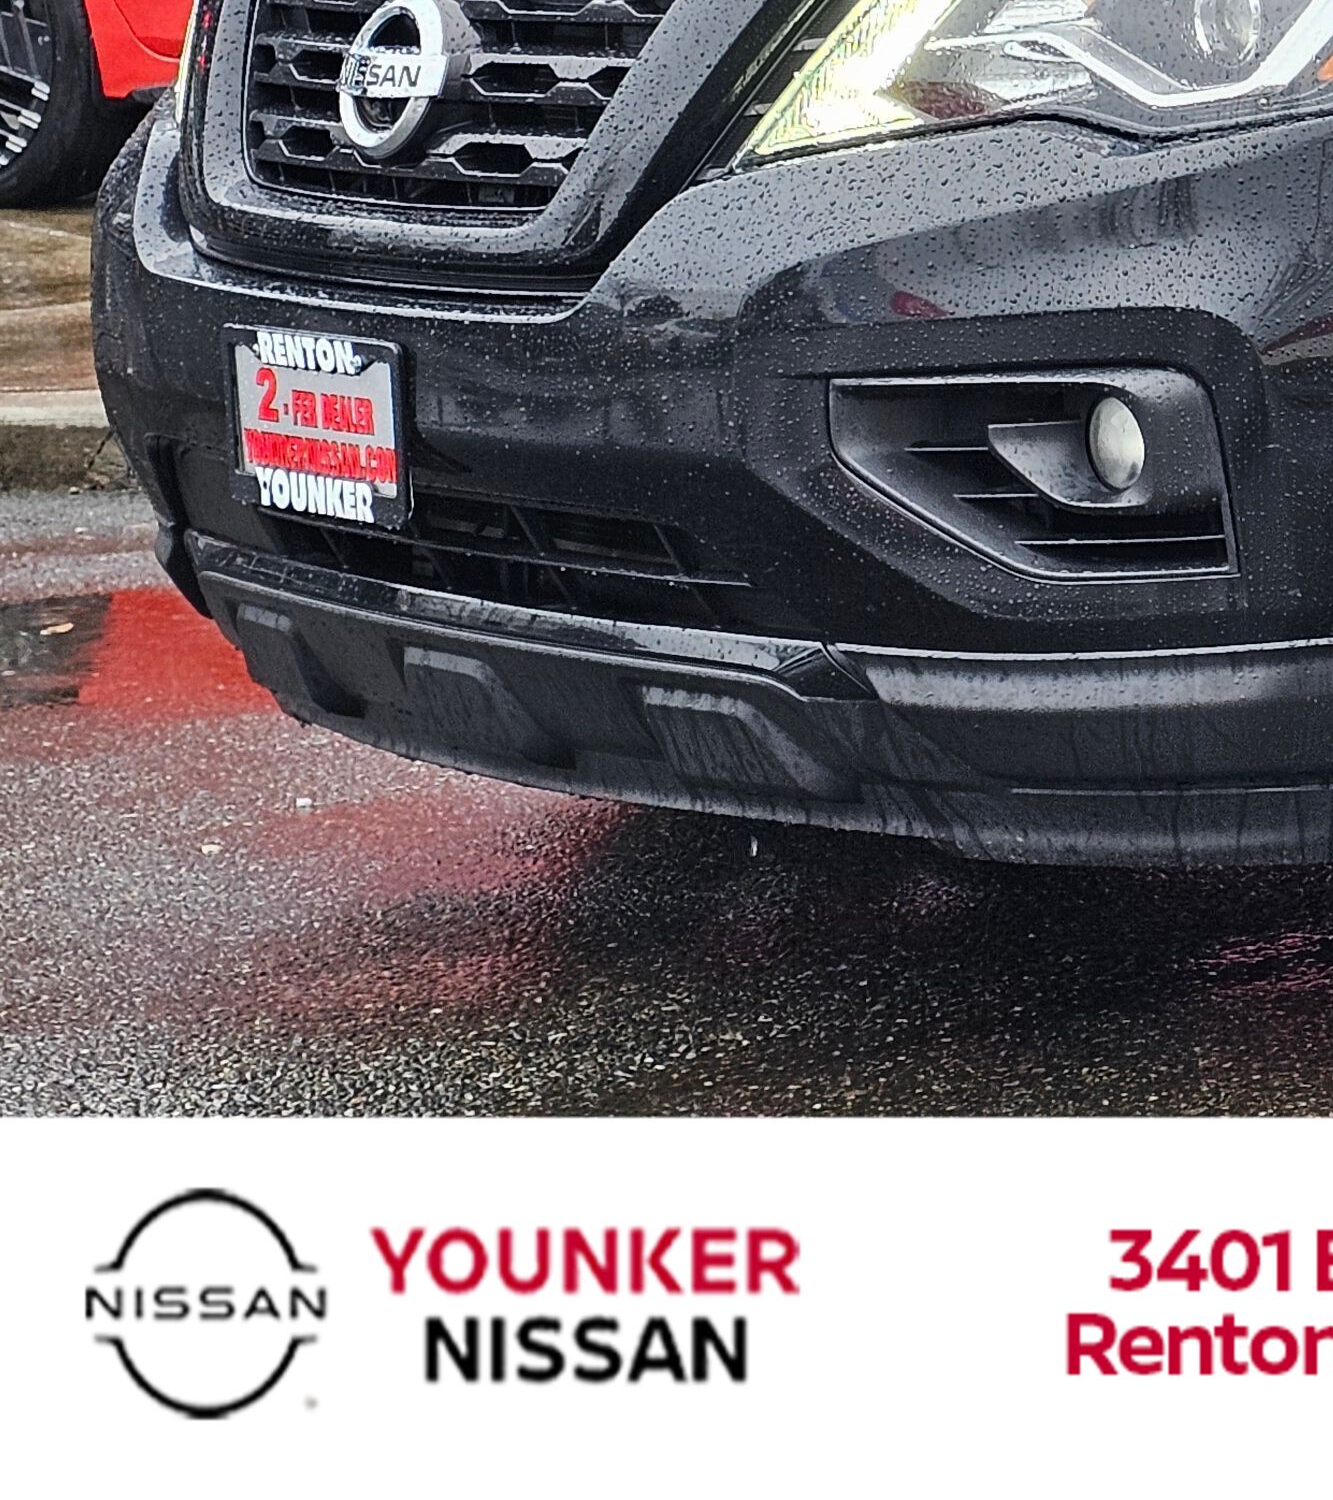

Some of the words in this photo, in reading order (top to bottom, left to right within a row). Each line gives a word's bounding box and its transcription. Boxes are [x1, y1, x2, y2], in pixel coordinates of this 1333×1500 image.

[256, 330, 356, 376] RENTON
[321, 392, 375, 436] DEALER
[255, 466, 375, 524] YOUNKER
